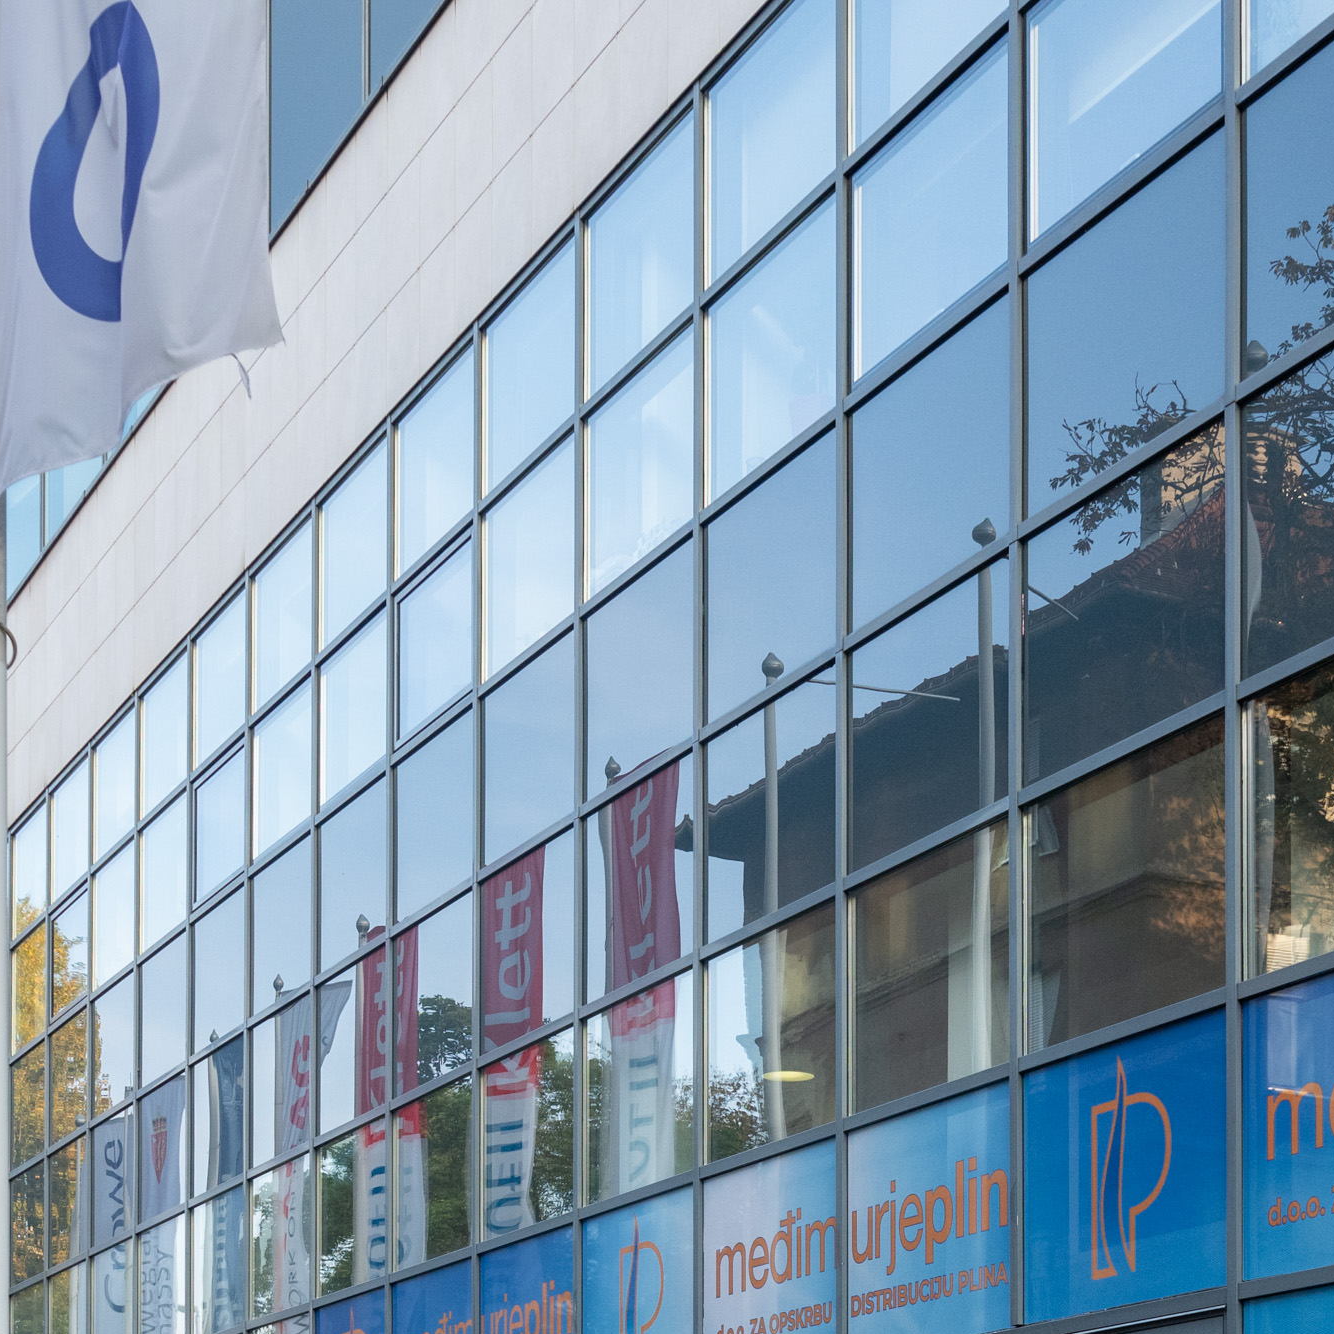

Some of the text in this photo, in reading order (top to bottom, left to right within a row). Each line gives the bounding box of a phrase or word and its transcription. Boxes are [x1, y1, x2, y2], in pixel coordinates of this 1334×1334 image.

[484, 871, 531, 1089] Klett
[1268, 1197, 1326, 1228] d.o.o.
[769, 1301, 833, 1334] OPSKRBU
[851, 1273, 954, 1318] DISTRIBUCIJU
[958, 1261, 1009, 1295] PLINA
